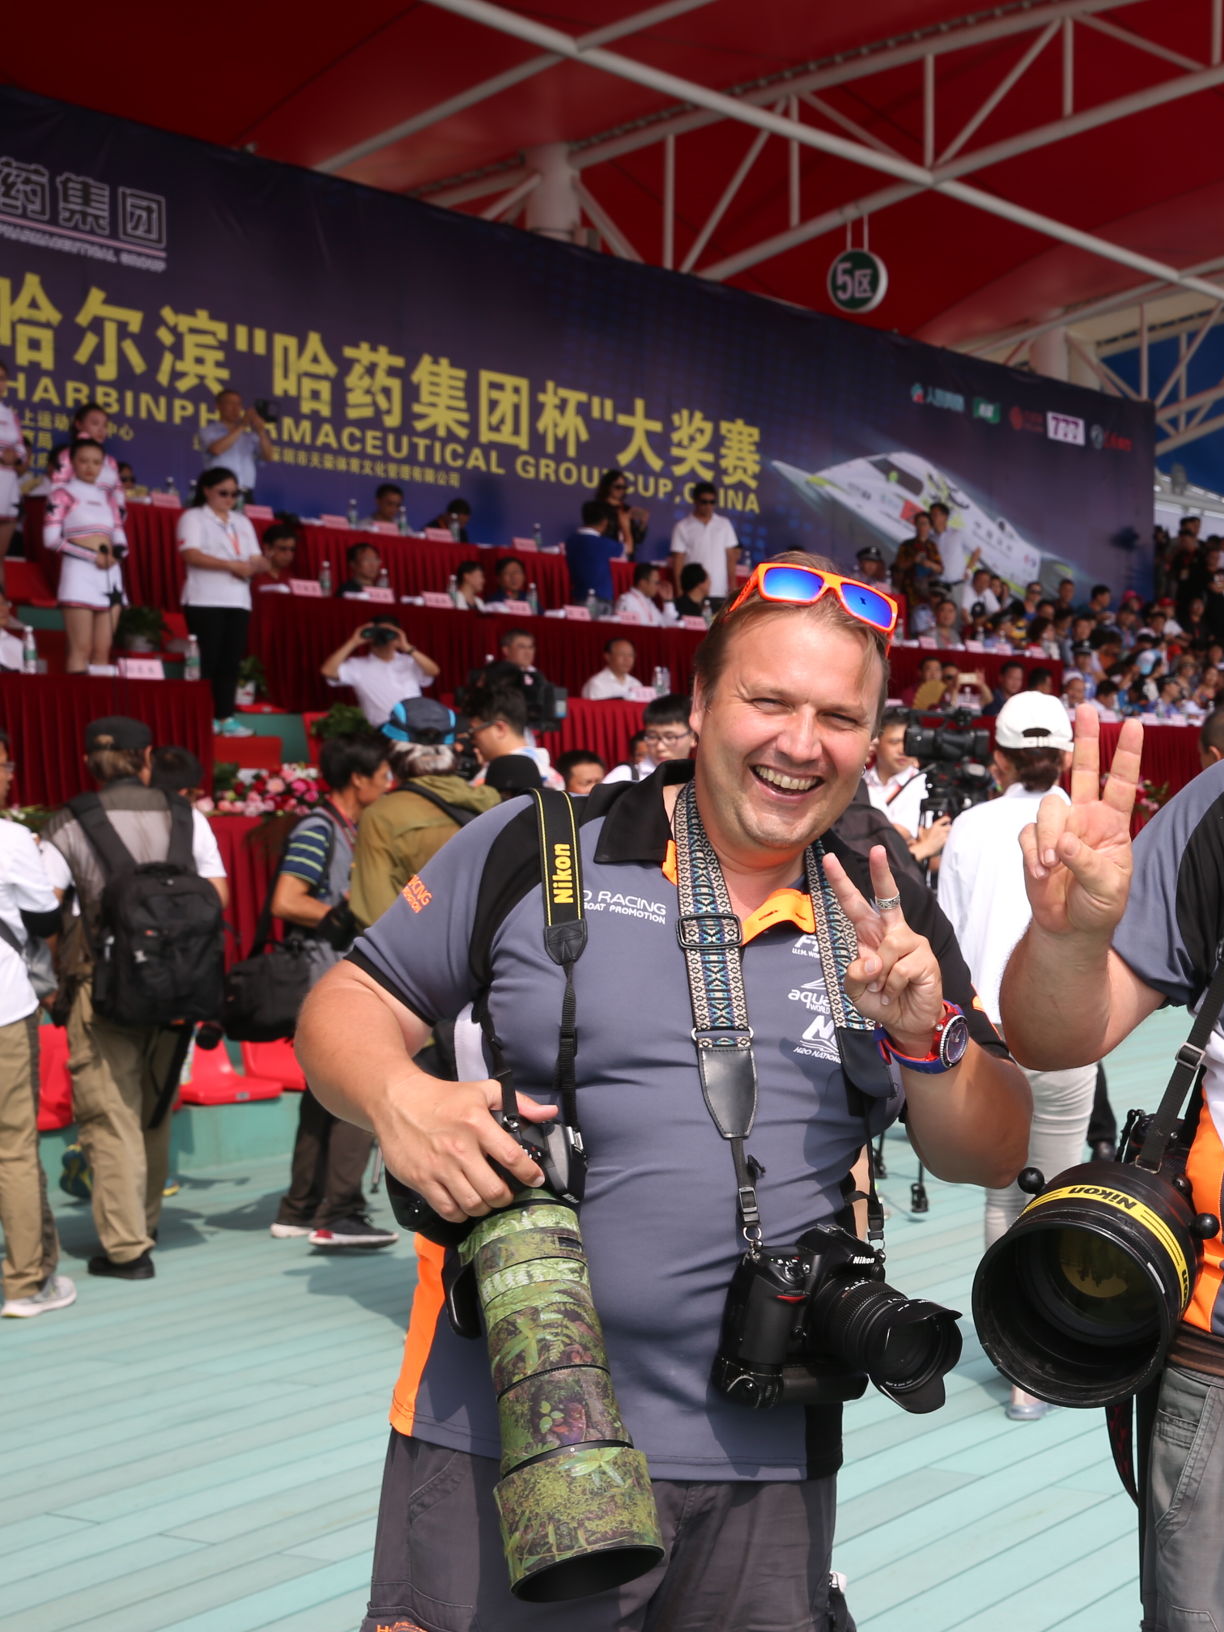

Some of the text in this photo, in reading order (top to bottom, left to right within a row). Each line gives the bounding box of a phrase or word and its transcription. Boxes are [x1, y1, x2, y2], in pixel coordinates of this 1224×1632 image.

[835, 262, 873, 299] 5区
[515, 454, 608, 489] GROU
[552, 843, 574, 904] Nikon
[598, 890, 667, 916] RACING
[609, 904, 666, 925] PROMOTION
[1068, 1187, 1137, 1210] Nikon
[852, 1256, 875, 1265] Nikon
